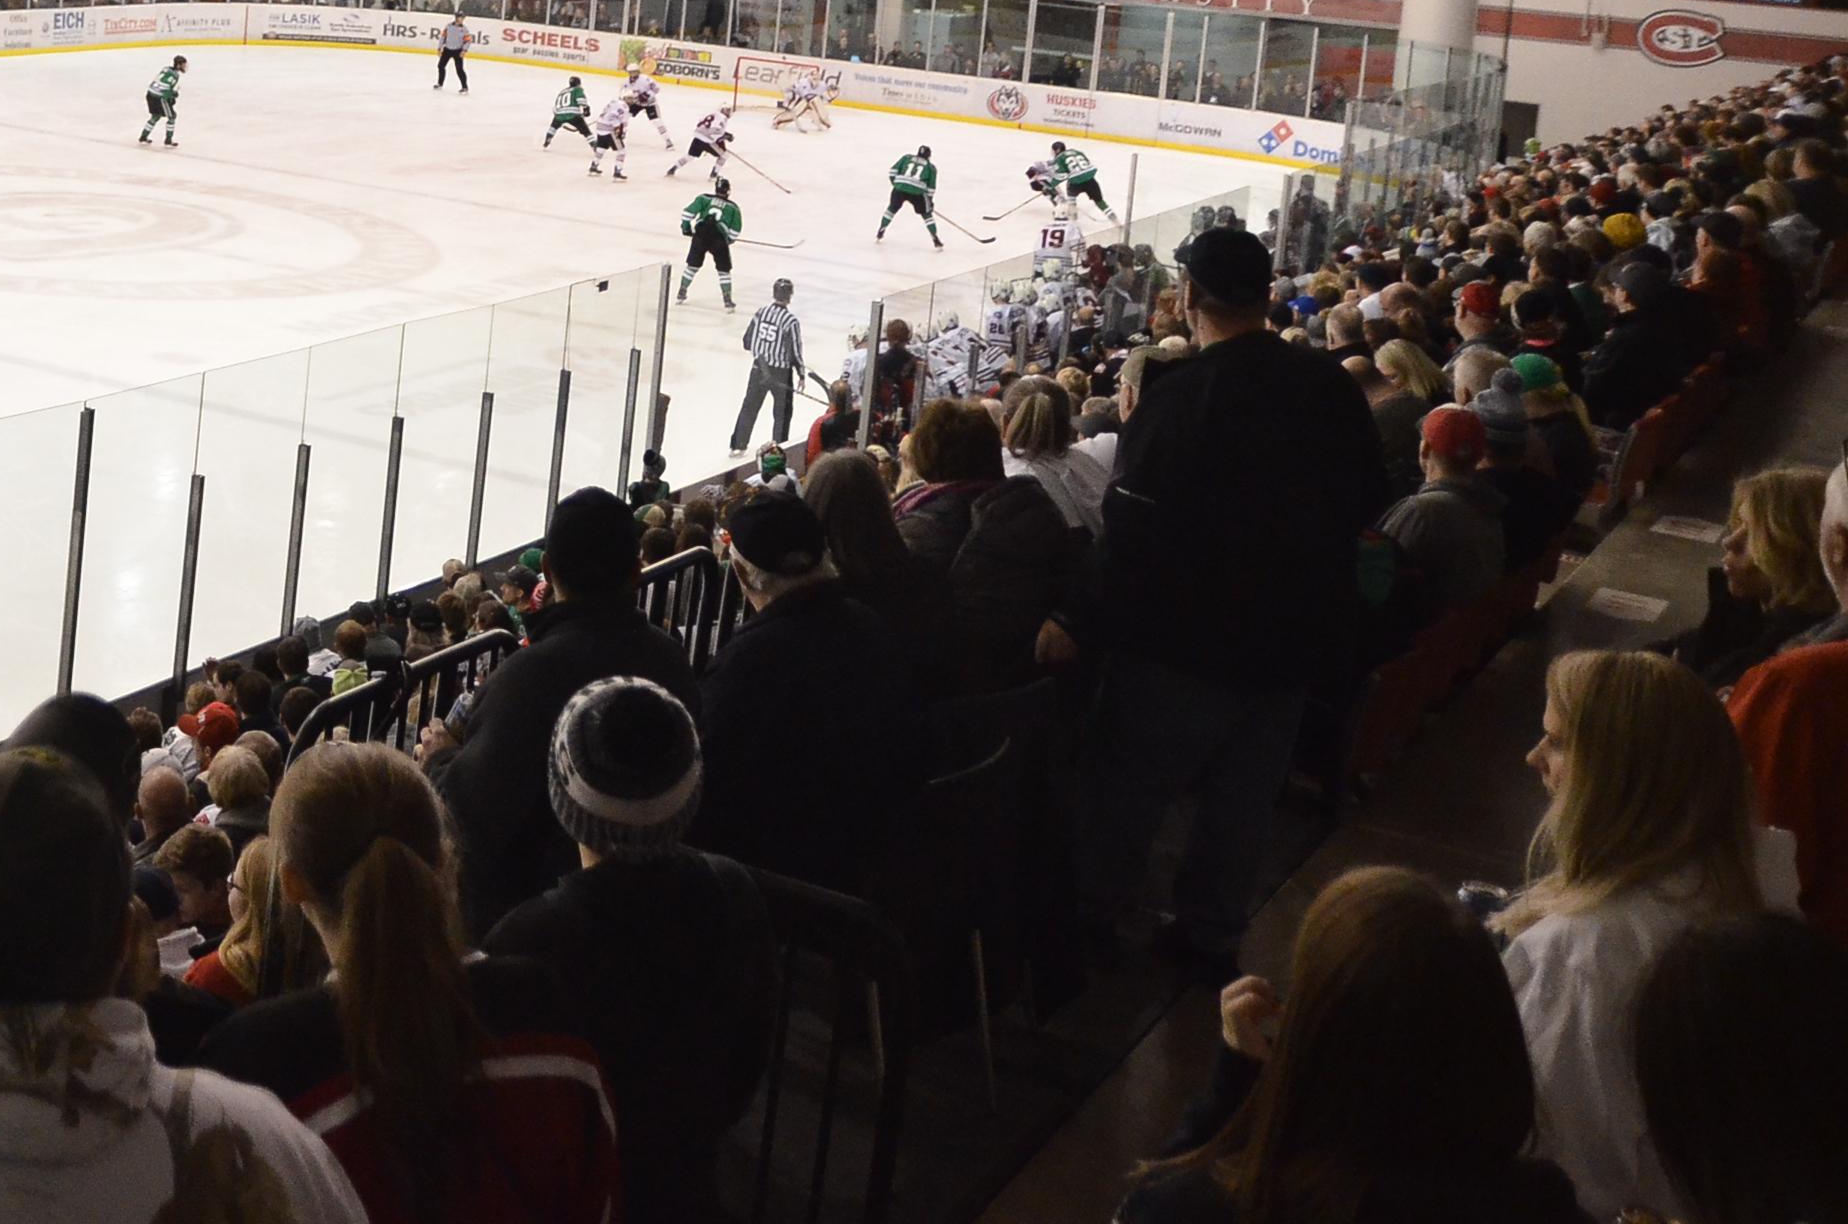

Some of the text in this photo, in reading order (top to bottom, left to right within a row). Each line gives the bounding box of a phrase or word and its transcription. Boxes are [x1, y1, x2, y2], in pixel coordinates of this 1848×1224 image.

[53, 12, 85, 30] EICH
[281, 13, 321, 25] LASIK
[501, 27, 601, 54] SCHEELS
[555, 93, 571, 108] 10
[1046, 93, 1097, 111] HUSKIES
[1053, 109, 1087, 119] TICKETS
[1158, 121, 1222, 138] McGOWAN
[904, 162, 925, 179] 11
[1065, 155, 1090, 171] 26
[1040, 228, 1066, 249] 19
[757, 324, 778, 343] 55
